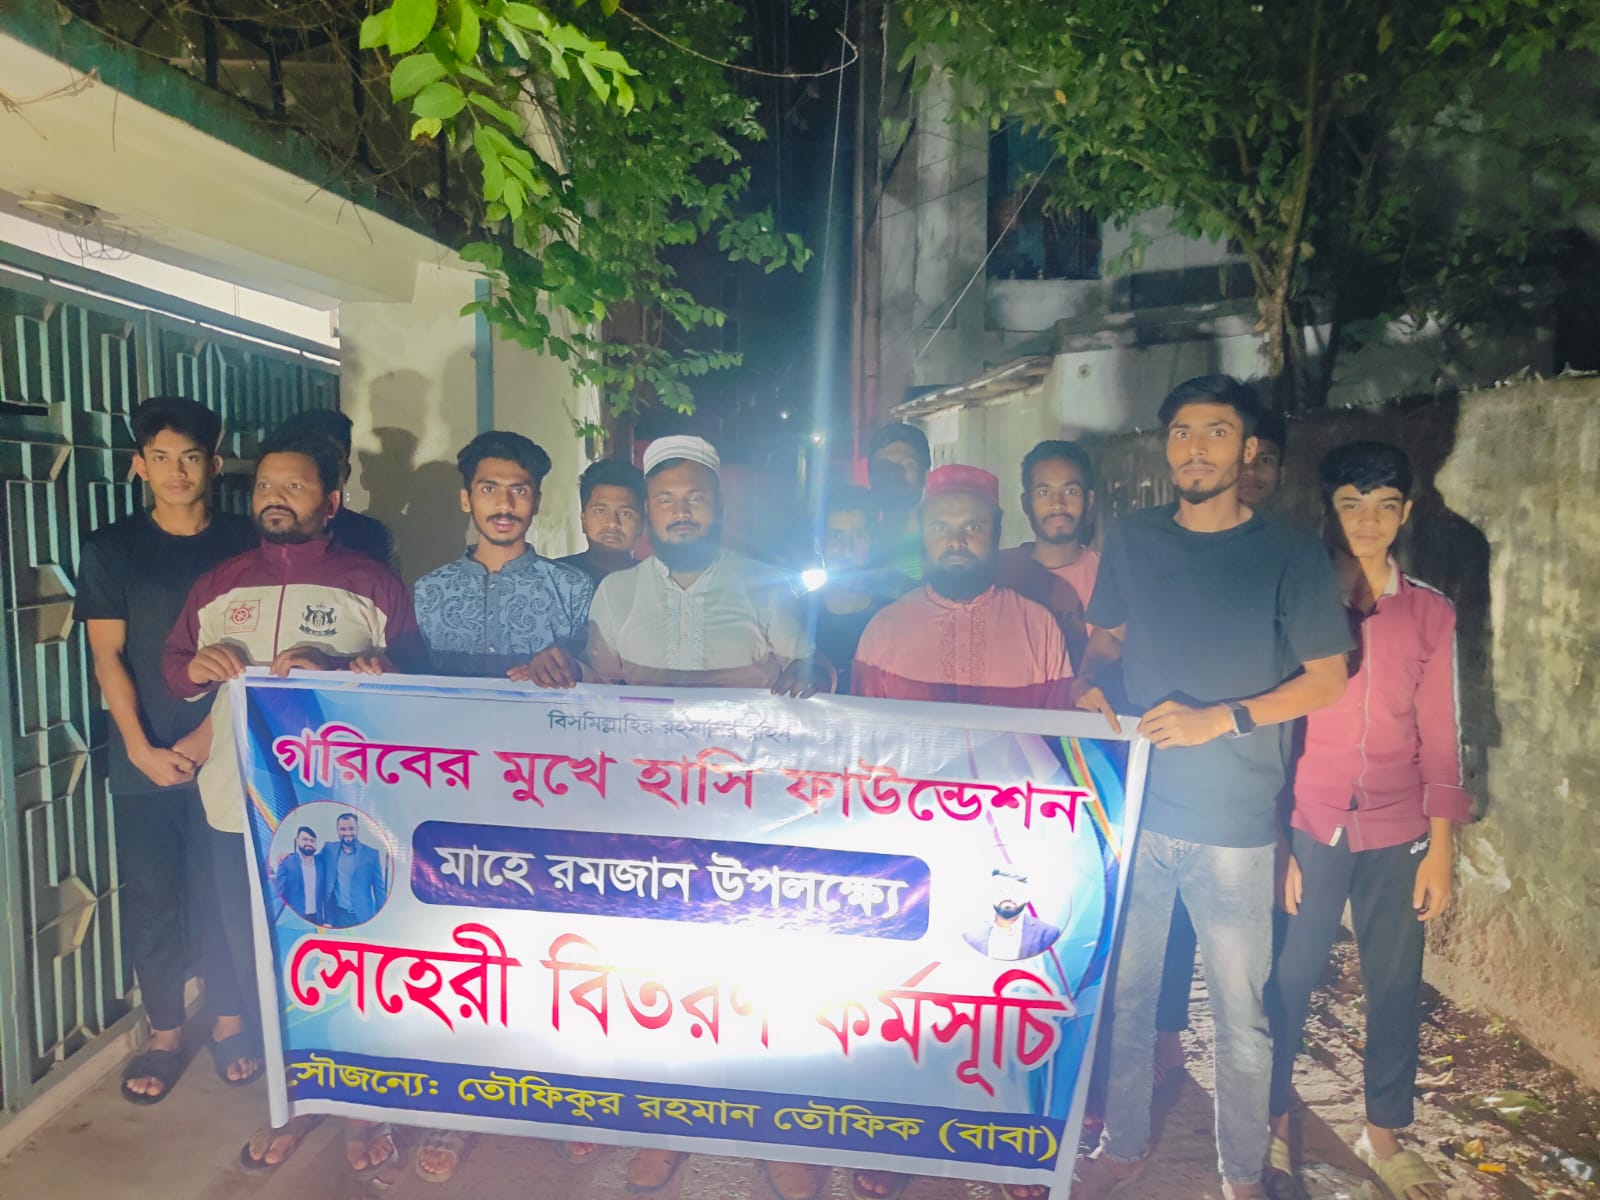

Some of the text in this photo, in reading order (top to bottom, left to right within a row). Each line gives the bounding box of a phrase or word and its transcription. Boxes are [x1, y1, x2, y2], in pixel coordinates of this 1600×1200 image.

[275, 725, 1090, 833] গরিবের মুখে হাসি ফাউন্ডেশন
[433, 844, 909, 918] মাহে রমজান উপলক্ষ্যে
[290, 922, 522, 1033] সেহেরী
[815, 961, 1070, 1097] কর্মসূচি
[458, 1072, 626, 1120] তৌফিকুর
[635, 1094, 761, 1127] রহমান
[774, 1101, 925, 1141] তৌফিক
[938, 1117, 1059, 1162] (বাবা)
